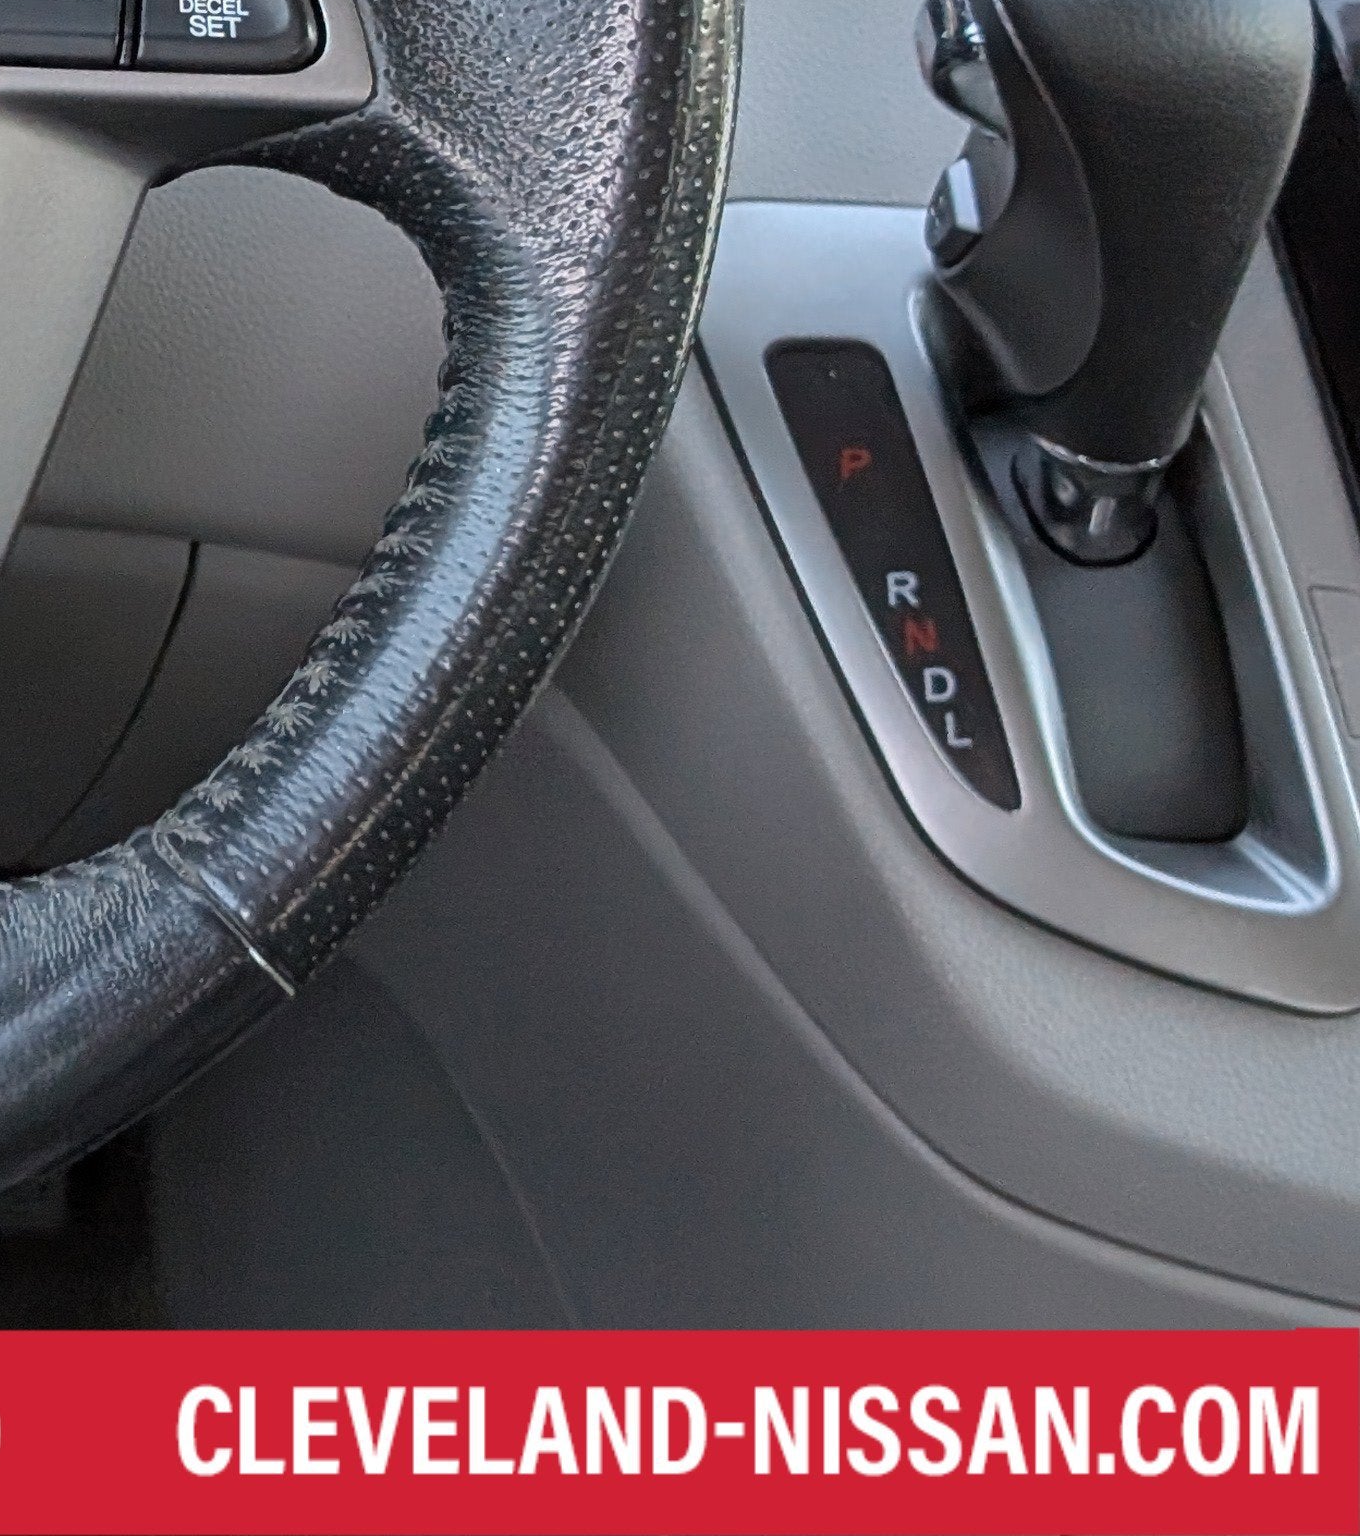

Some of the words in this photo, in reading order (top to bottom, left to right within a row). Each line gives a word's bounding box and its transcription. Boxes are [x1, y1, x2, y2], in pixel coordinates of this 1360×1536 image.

[188, 16, 243, 40] SET
[838, 447, 872, 480] P
[885, 570, 921, 608] R
[902, 617, 940, 656] N
[922, 666, 958, 704] D
[945, 713, 973, 749] L
